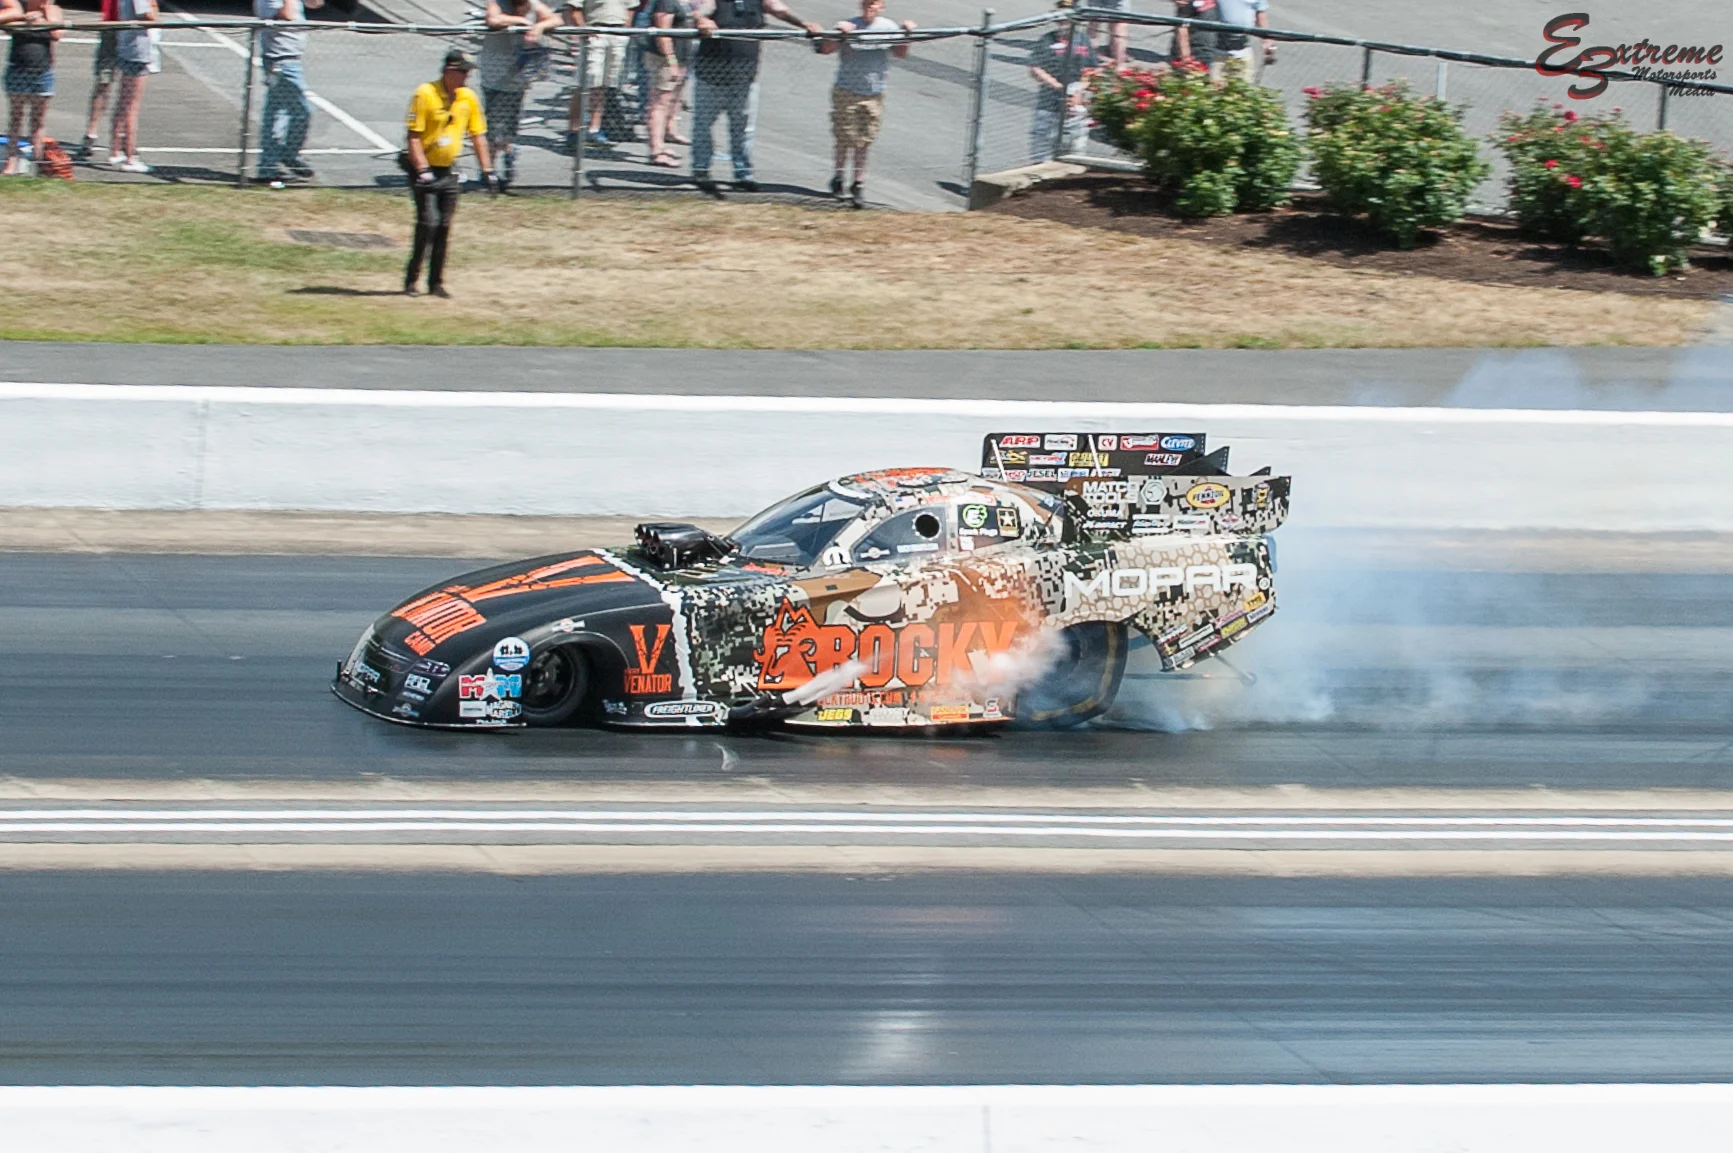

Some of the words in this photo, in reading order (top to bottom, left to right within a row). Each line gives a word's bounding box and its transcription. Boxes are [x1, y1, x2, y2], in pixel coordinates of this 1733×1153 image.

[1001, 436, 1039, 446] ARP
[1064, 563, 1257, 598] MOPAR
[629, 624, 671, 674] V
[815, 621, 1018, 688] ROCKY
[624, 673, 672, 694] VENATOR
[652, 703, 714, 714] FREIGHTLINER
[818, 708, 853, 720] JEGS
